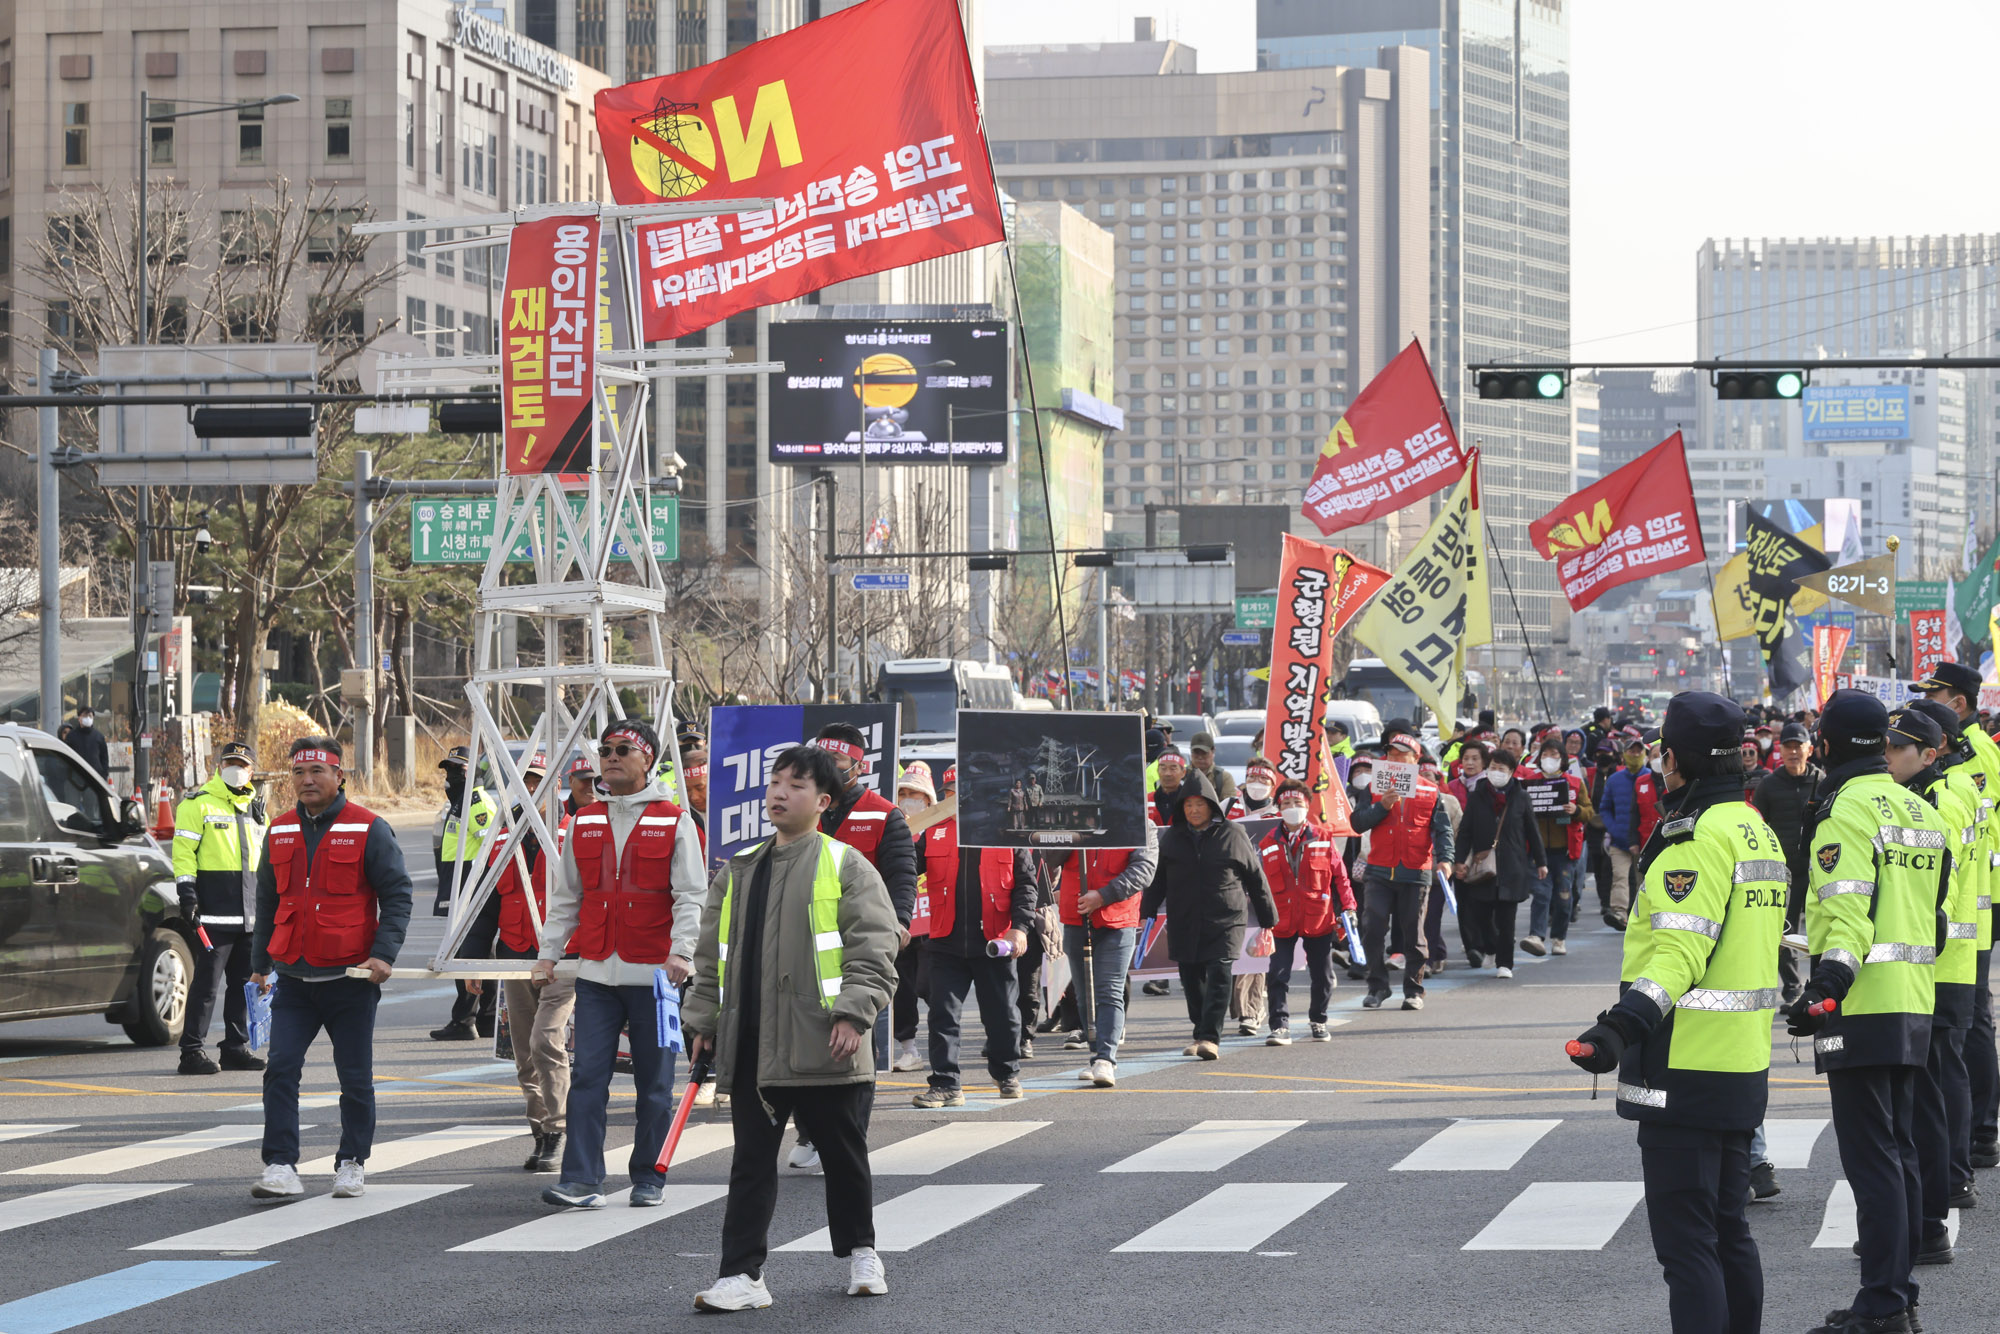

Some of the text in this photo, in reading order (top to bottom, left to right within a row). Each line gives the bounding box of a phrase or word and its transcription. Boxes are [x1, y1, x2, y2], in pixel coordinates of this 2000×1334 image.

[476, 19, 507, 60] SEOUL
[507, 35, 547, 79] FINANCE
[546, 55, 577, 90] CENTER
[550, 225, 590, 397] 용인산단
[1806, 398, 1906, 424] 기프트인포
[421, 509, 432, 519] 60
[439, 503, 491, 520] 숭례문
[440, 534, 467, 550] 시청
[441, 550, 481, 560] City Hall
[1827, 575, 1889, 595] 62기-3
[1278, 662, 1320, 780] 지역발전
[293, 750, 327, 764] 사반대
[683, 763, 707, 778] 사반대
[1872, 795, 1925, 823] 경찰
[641, 830, 666, 838] 송전선로
[850, 825, 872, 833] 송전선로
